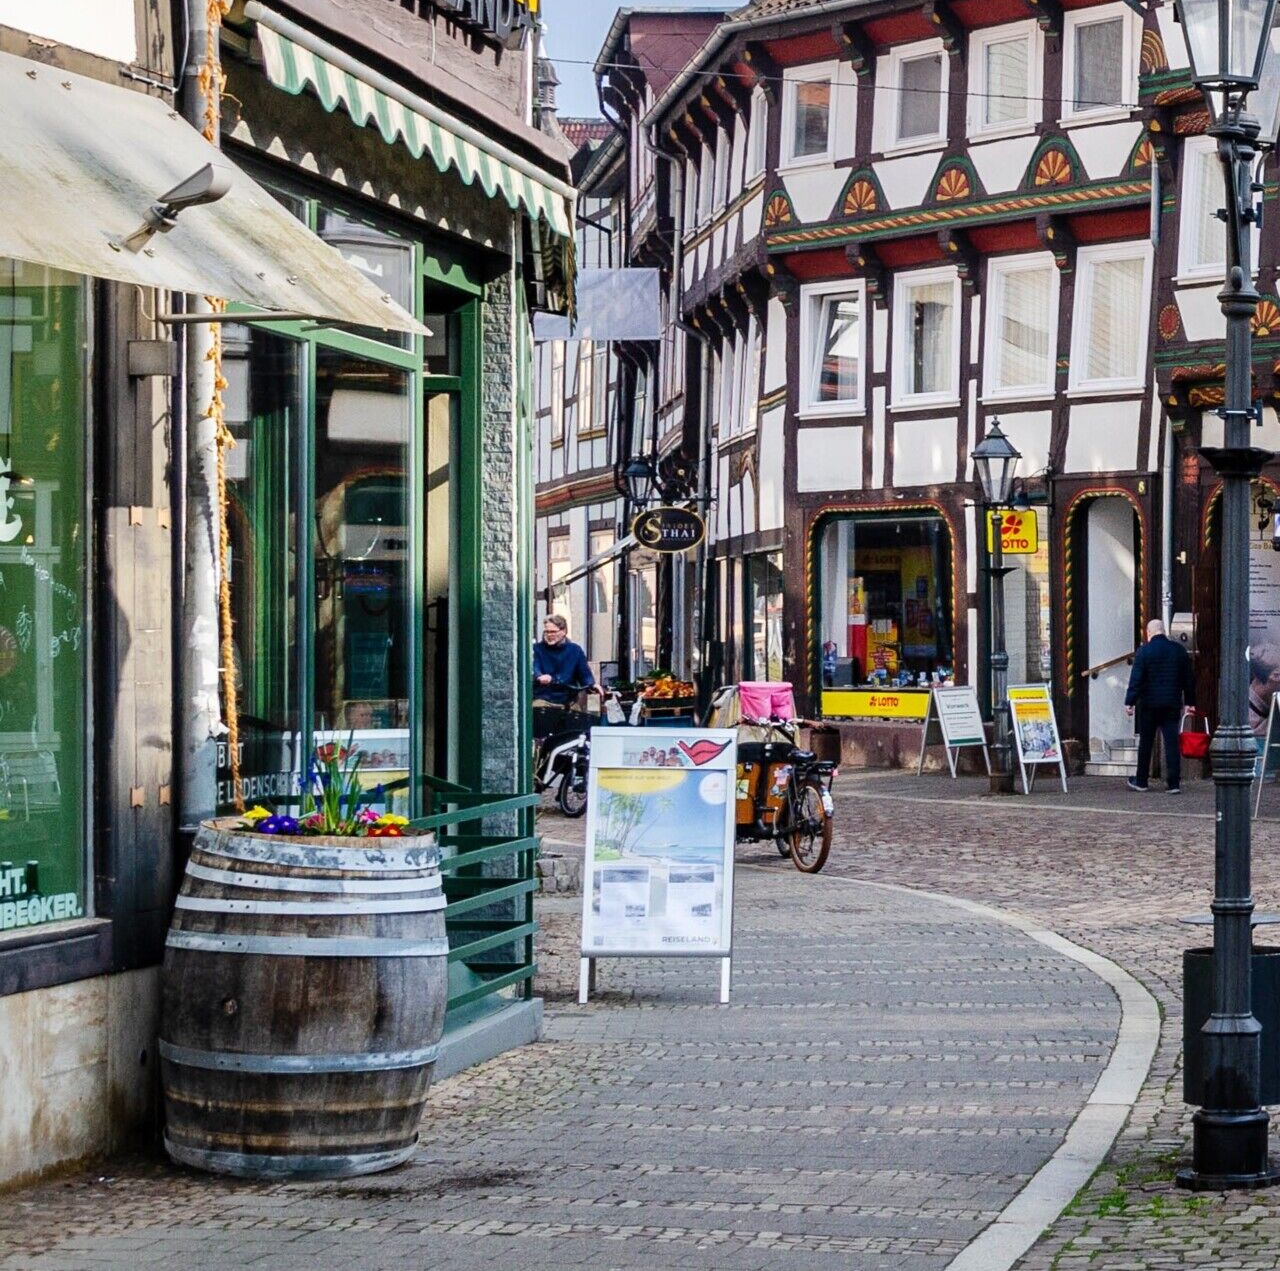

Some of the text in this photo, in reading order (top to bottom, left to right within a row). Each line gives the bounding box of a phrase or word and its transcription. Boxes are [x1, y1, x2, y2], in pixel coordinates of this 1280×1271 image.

[662, 528, 696, 538] THAI
[1002, 538, 1029, 549] OTTO
[877, 696, 899, 707] LOTTO
[0, 892, 83, 931] BECKER.
